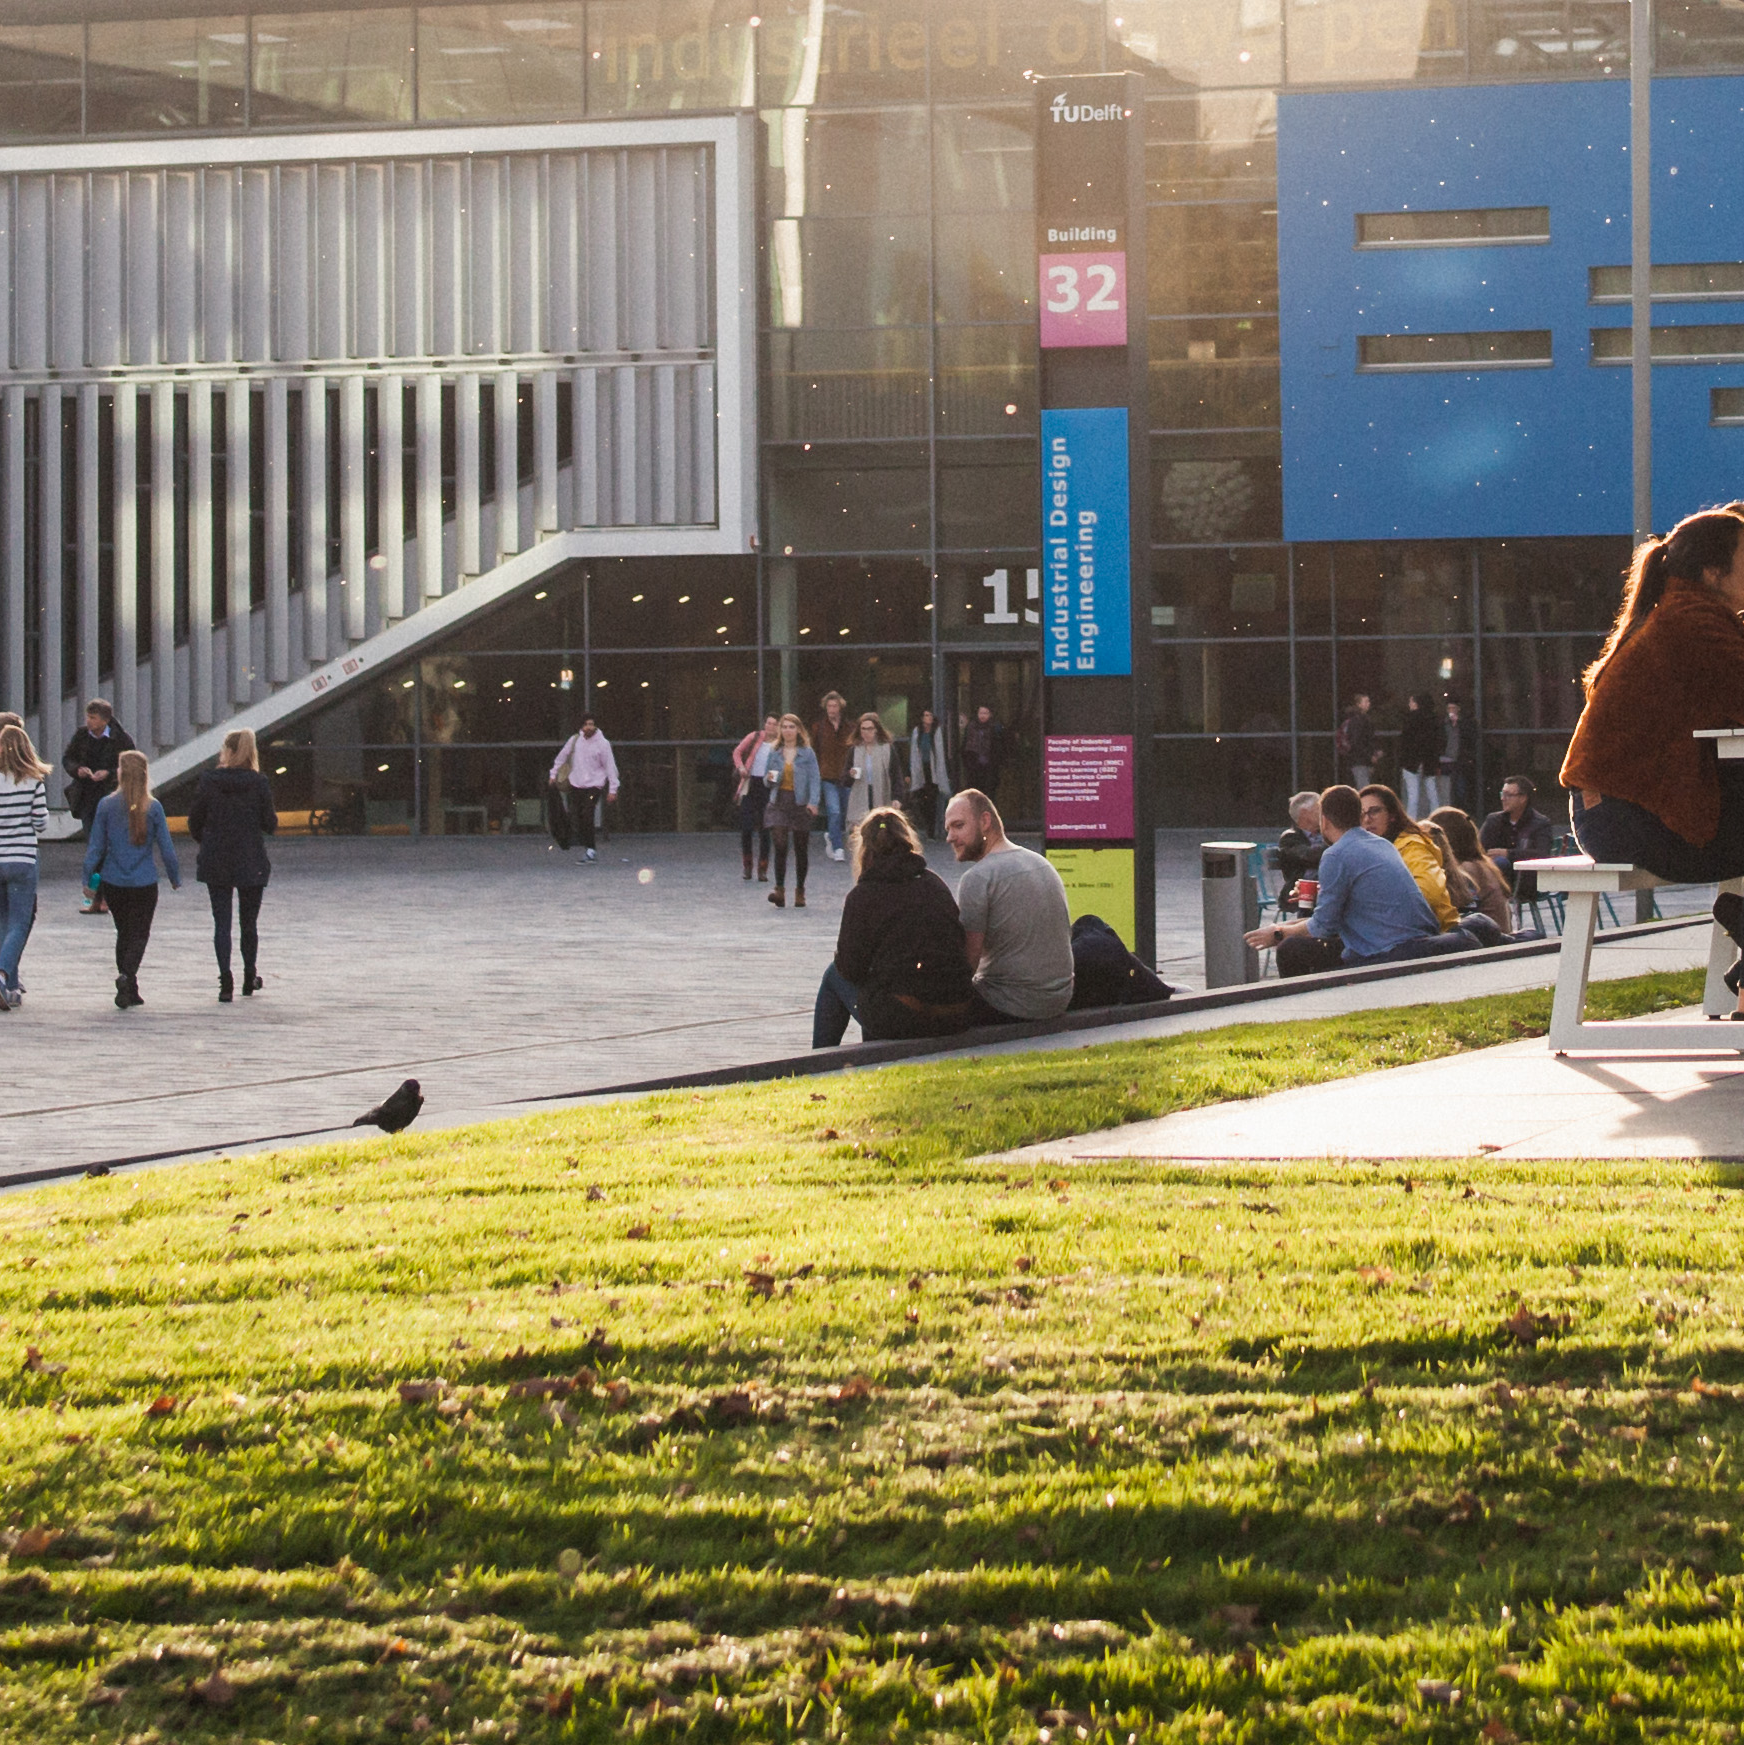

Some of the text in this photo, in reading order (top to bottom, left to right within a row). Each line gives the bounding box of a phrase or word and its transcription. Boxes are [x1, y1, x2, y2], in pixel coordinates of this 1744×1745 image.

[1048, 227, 1117, 243] Building
[1047, 264, 1119, 313] 32
[1048, 437, 1071, 670] Industrial Design
[1075, 510, 1099, 670] Engineering
